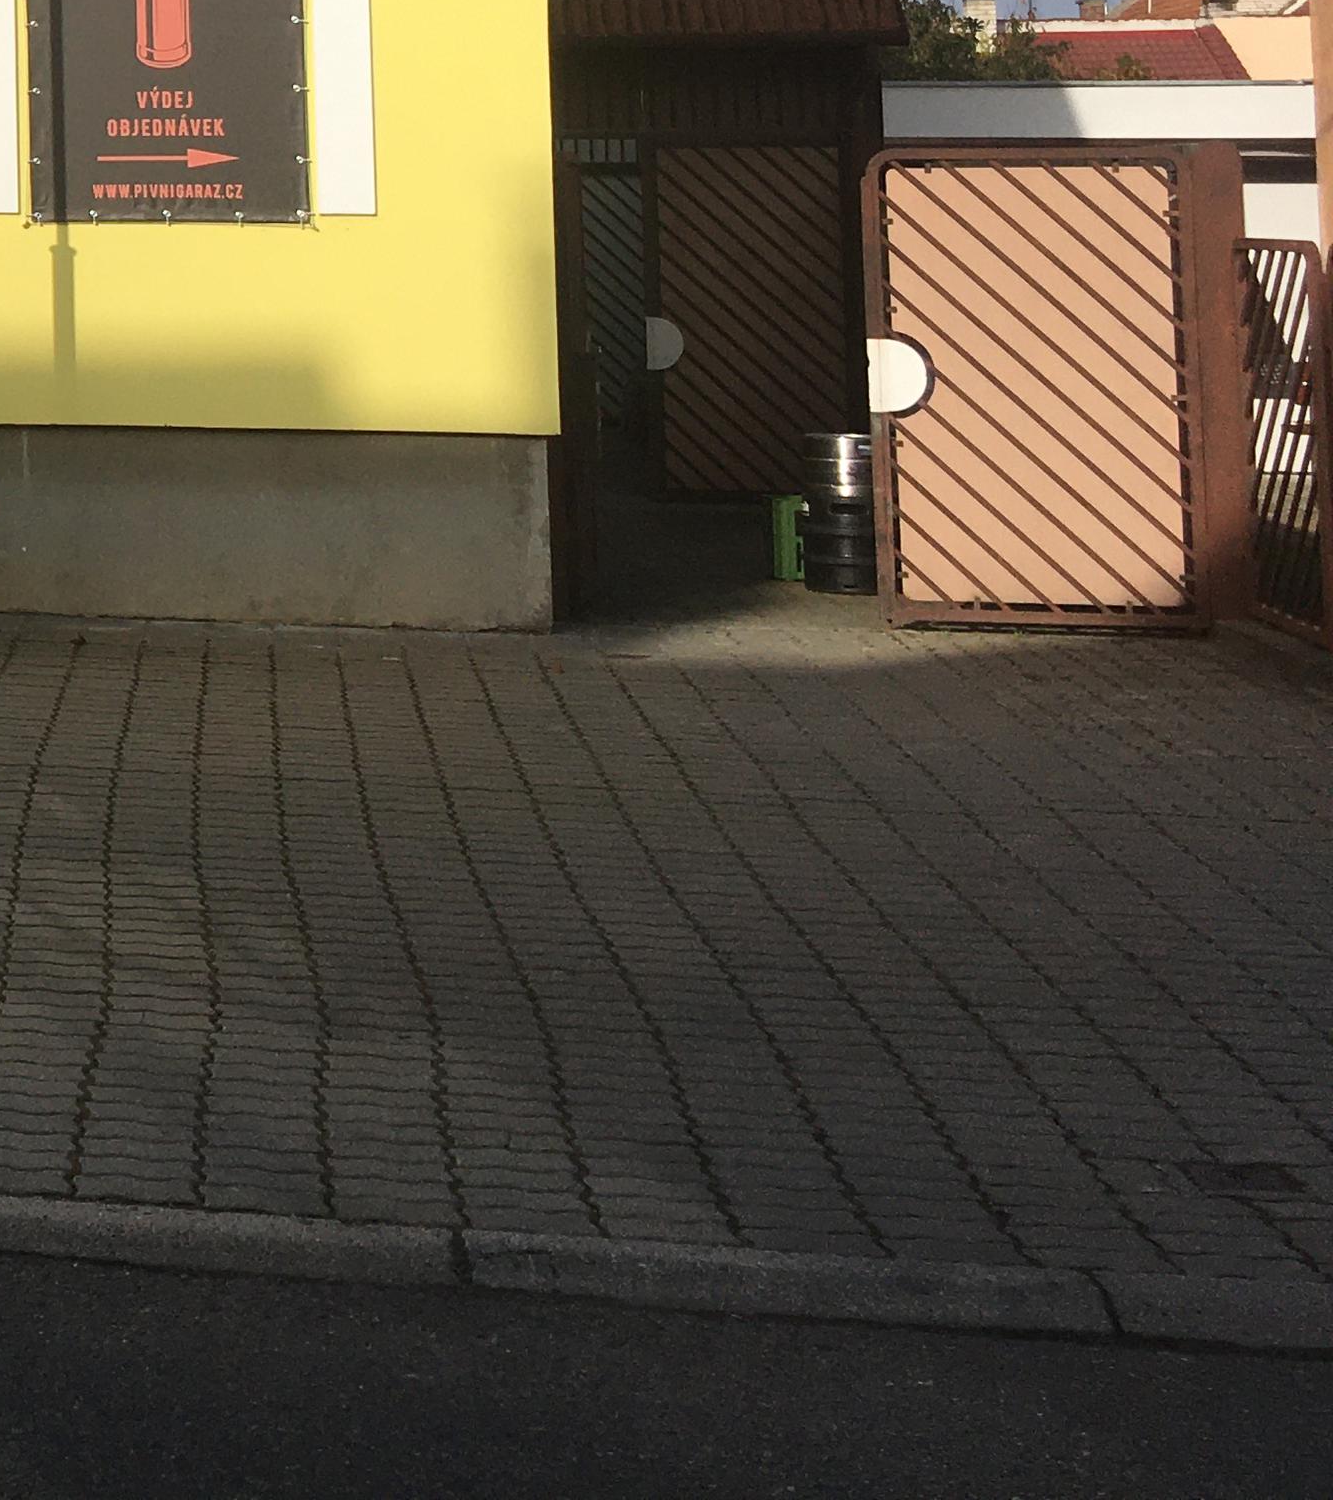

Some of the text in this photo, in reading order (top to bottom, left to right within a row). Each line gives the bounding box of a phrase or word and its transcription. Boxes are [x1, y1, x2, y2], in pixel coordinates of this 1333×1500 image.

[136, 85, 194, 109] VÝDEJ
[107, 114, 226, 137] OBJEDNÁVEK
[92, 183, 244, 199] WWW.PIVNIGARAZ.CZ
